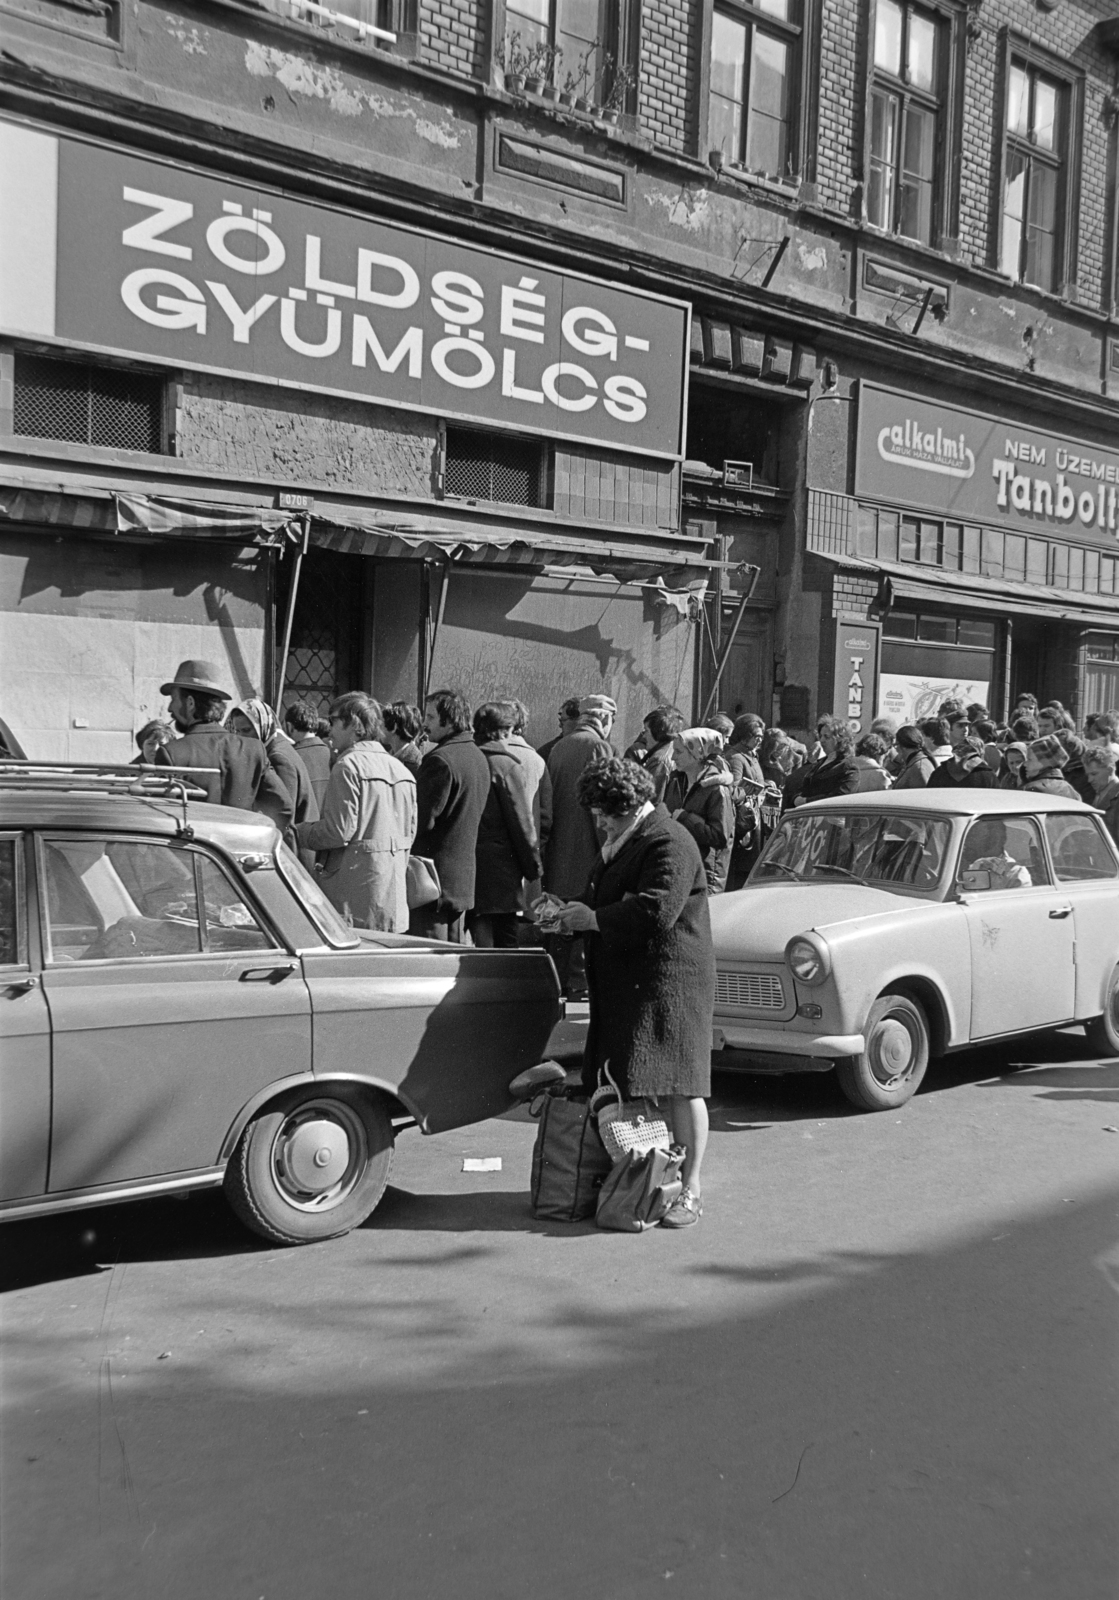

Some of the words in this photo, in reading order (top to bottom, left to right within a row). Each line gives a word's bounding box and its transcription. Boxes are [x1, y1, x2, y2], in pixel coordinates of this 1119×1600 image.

[122, 186, 650, 361] ZÖLDSÉG-
[121, 268, 648, 422] GYÜMÖLCS
[890, 419, 965, 461] alkalmi
[1004, 438, 1046, 467] NEM
[991, 458, 1119, 540] Tanbolt
